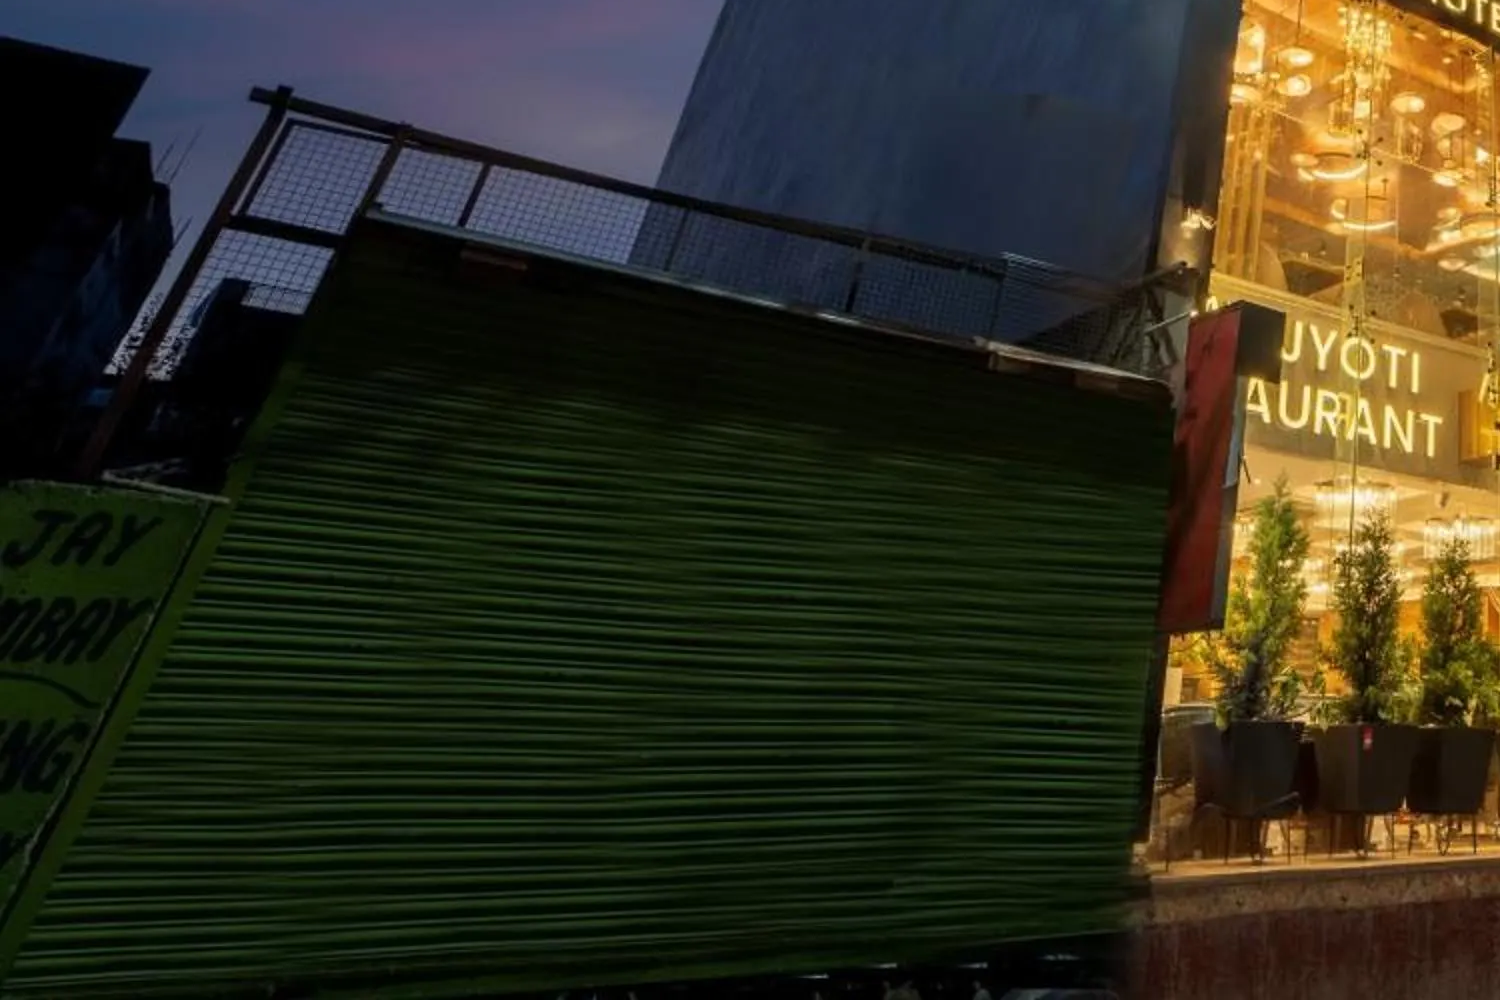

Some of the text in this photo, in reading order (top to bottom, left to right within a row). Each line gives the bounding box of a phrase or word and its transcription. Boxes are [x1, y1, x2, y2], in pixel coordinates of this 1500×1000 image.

[1281, 319, 1421, 394] JYOTI
[1246, 376, 1443, 457] AURANT
[3, 510, 163, 567] JAY
[0, 717, 90, 794] NG
